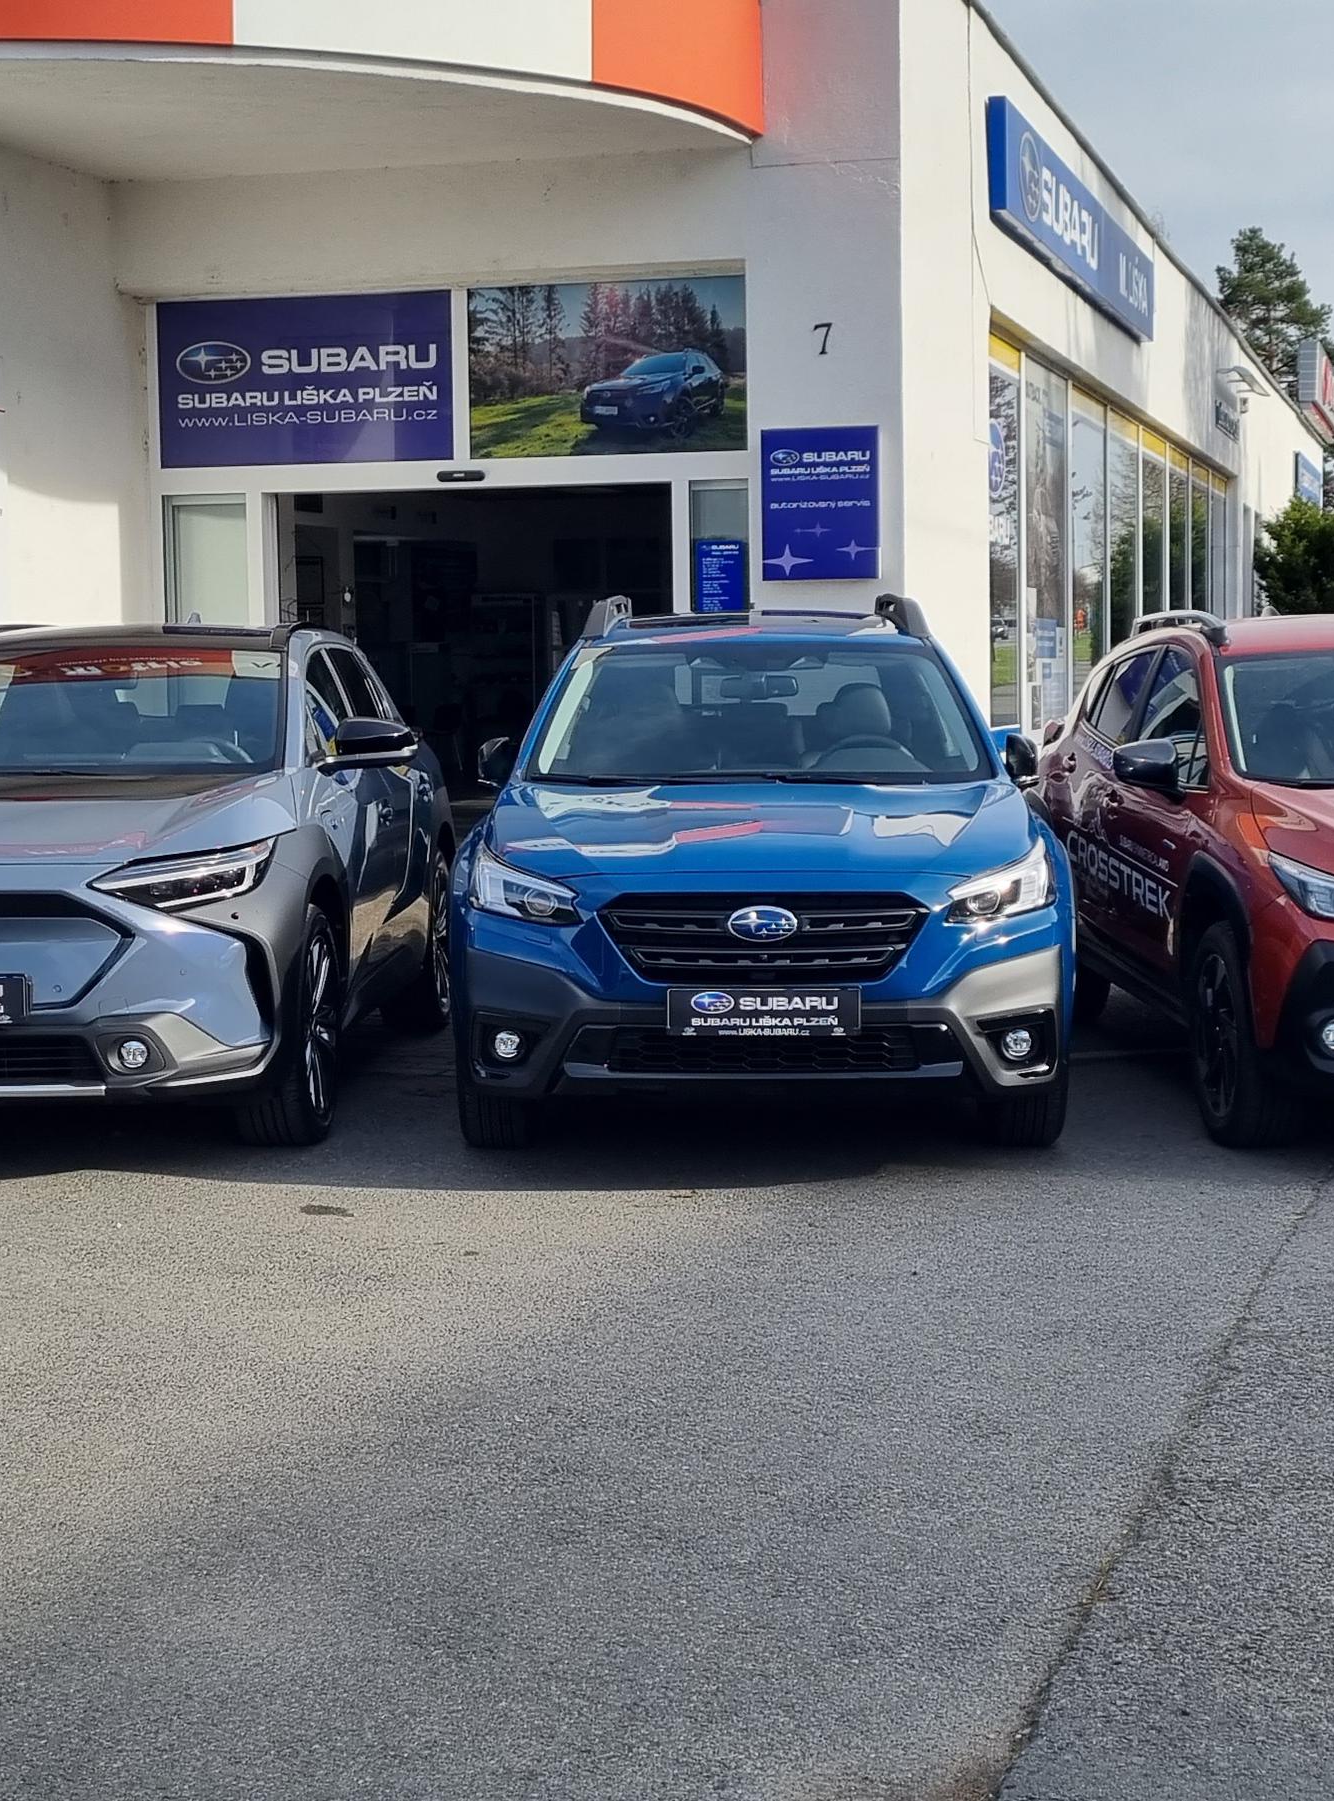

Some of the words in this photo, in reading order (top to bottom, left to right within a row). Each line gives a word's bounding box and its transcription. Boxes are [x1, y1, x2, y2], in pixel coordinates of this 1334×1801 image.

[1042, 167, 1098, 270] SUBARU
[813, 322, 833, 355] 7
[261, 344, 437, 374] SUBARU
[177, 391, 279, 409] SUBARU
[284, 385, 354, 406] LIŠKA
[358, 381, 437, 403] PLZEŇ
[179, 408, 438, 428] www.LISKA-SUBARU.cz
[802, 450, 870, 462] SUBARU
[770, 467, 810, 475] SUBARU
[811, 465, 838, 474] LIŠKA
[839, 463, 870, 473] PLZEŇ
[837, 499, 871, 507] servis
[1067, 830, 1171, 922] CROSSTREK
[739, 996, 838, 1011] SUBARU
[691, 1017, 750, 1026] SUBARU
[752, 1015, 792, 1026] LIŠKA
[794, 1016, 838, 1026] PLZEŇ
